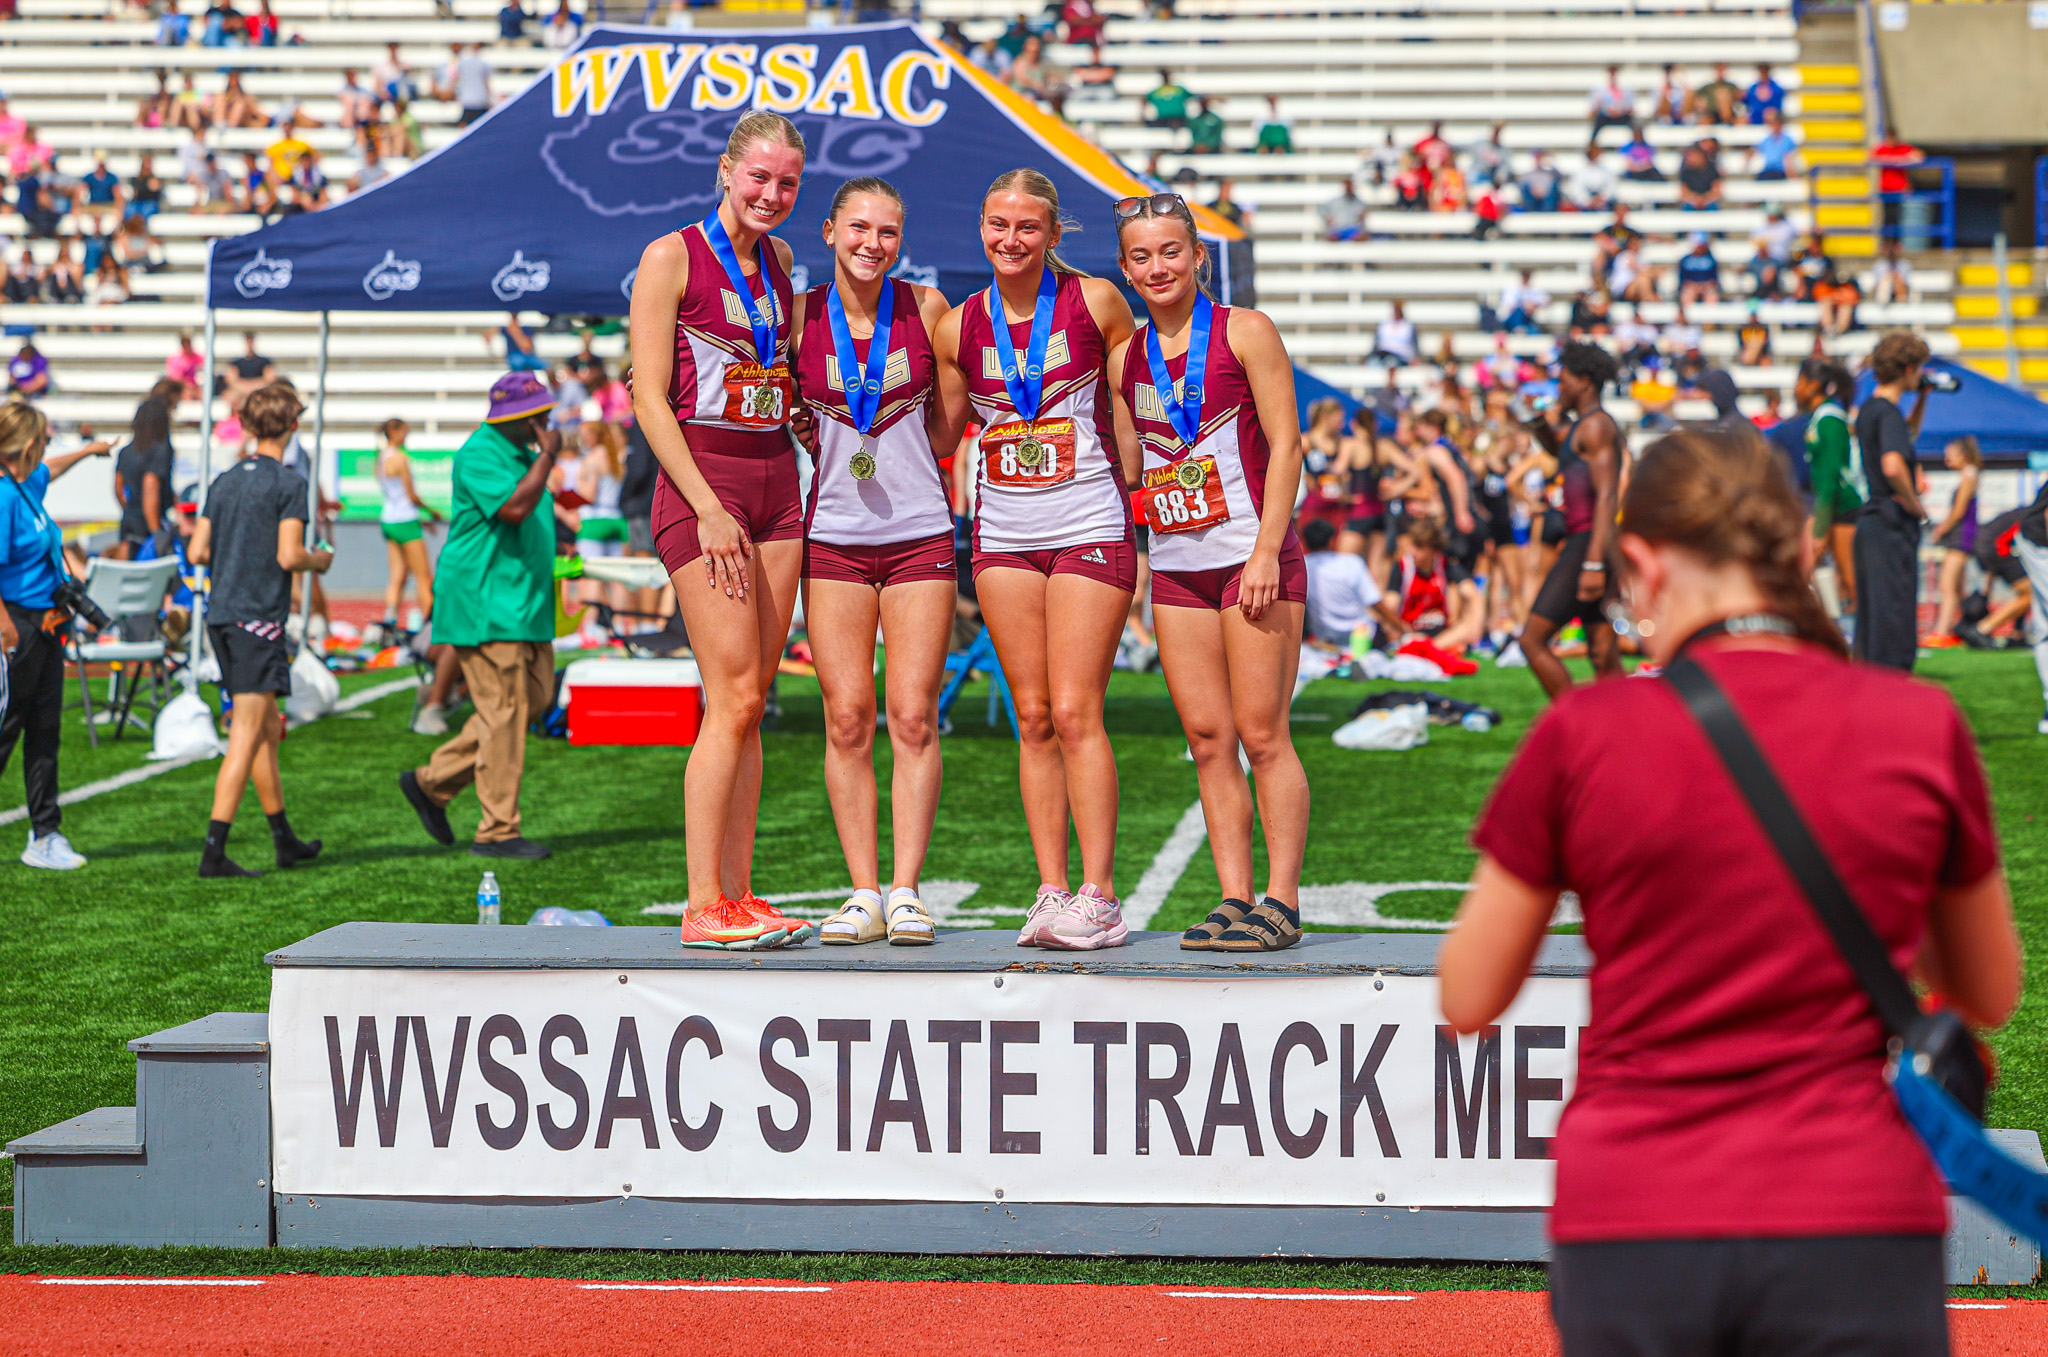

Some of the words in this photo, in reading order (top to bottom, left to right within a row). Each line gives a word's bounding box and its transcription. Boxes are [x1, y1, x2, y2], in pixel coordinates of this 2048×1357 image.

[552, 42, 951, 126] WVSSAC
[607, 109, 922, 176] SSC
[740, 385, 784, 420] 88
[1000, 443, 1057, 477] 80
[1154, 488, 1209, 526] 883
[324, 1014, 723, 1151] WVSSAC
[758, 1019, 1040, 1154] STATE
[1074, 1021, 1401, 1158] TRACK
[1435, 1024, 1588, 1159] ME
